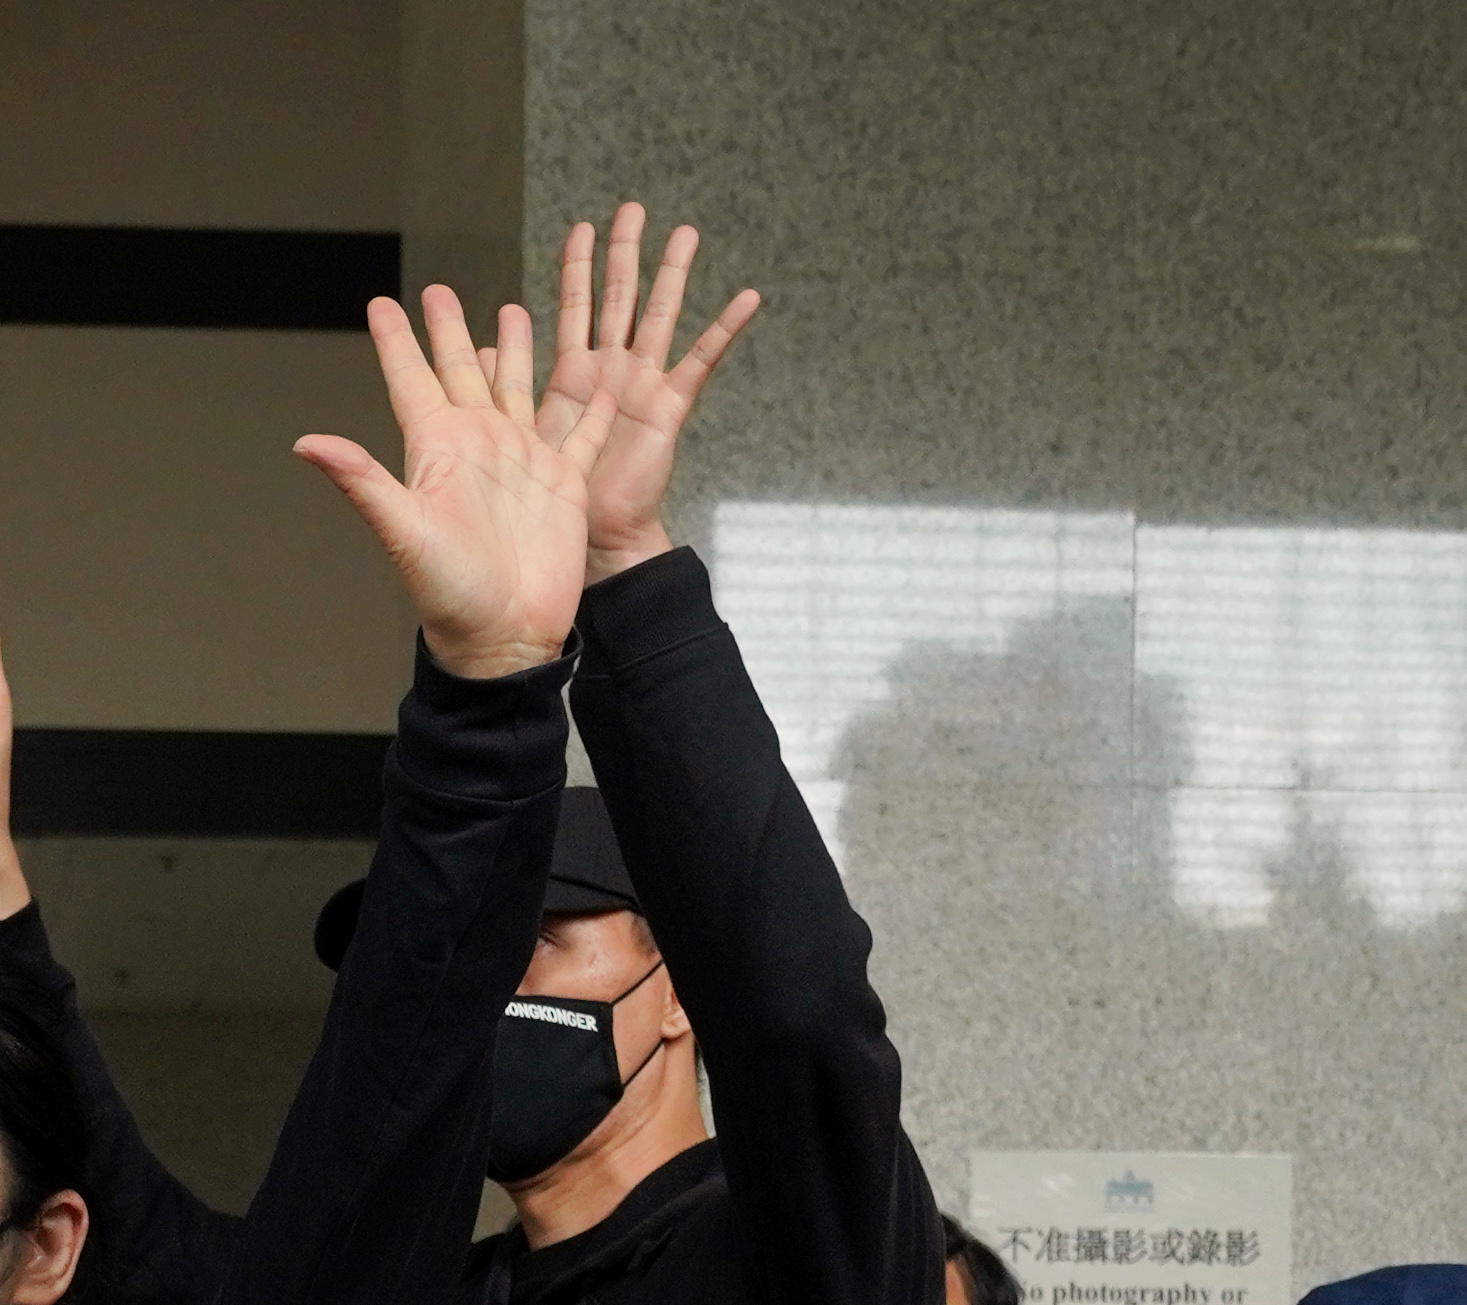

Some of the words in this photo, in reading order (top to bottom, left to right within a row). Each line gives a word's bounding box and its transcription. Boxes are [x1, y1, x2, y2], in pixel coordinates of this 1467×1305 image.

[998, 1225, 1262, 1267] 不准攝影或錄影
[1221, 1286, 1249, 1305] or
